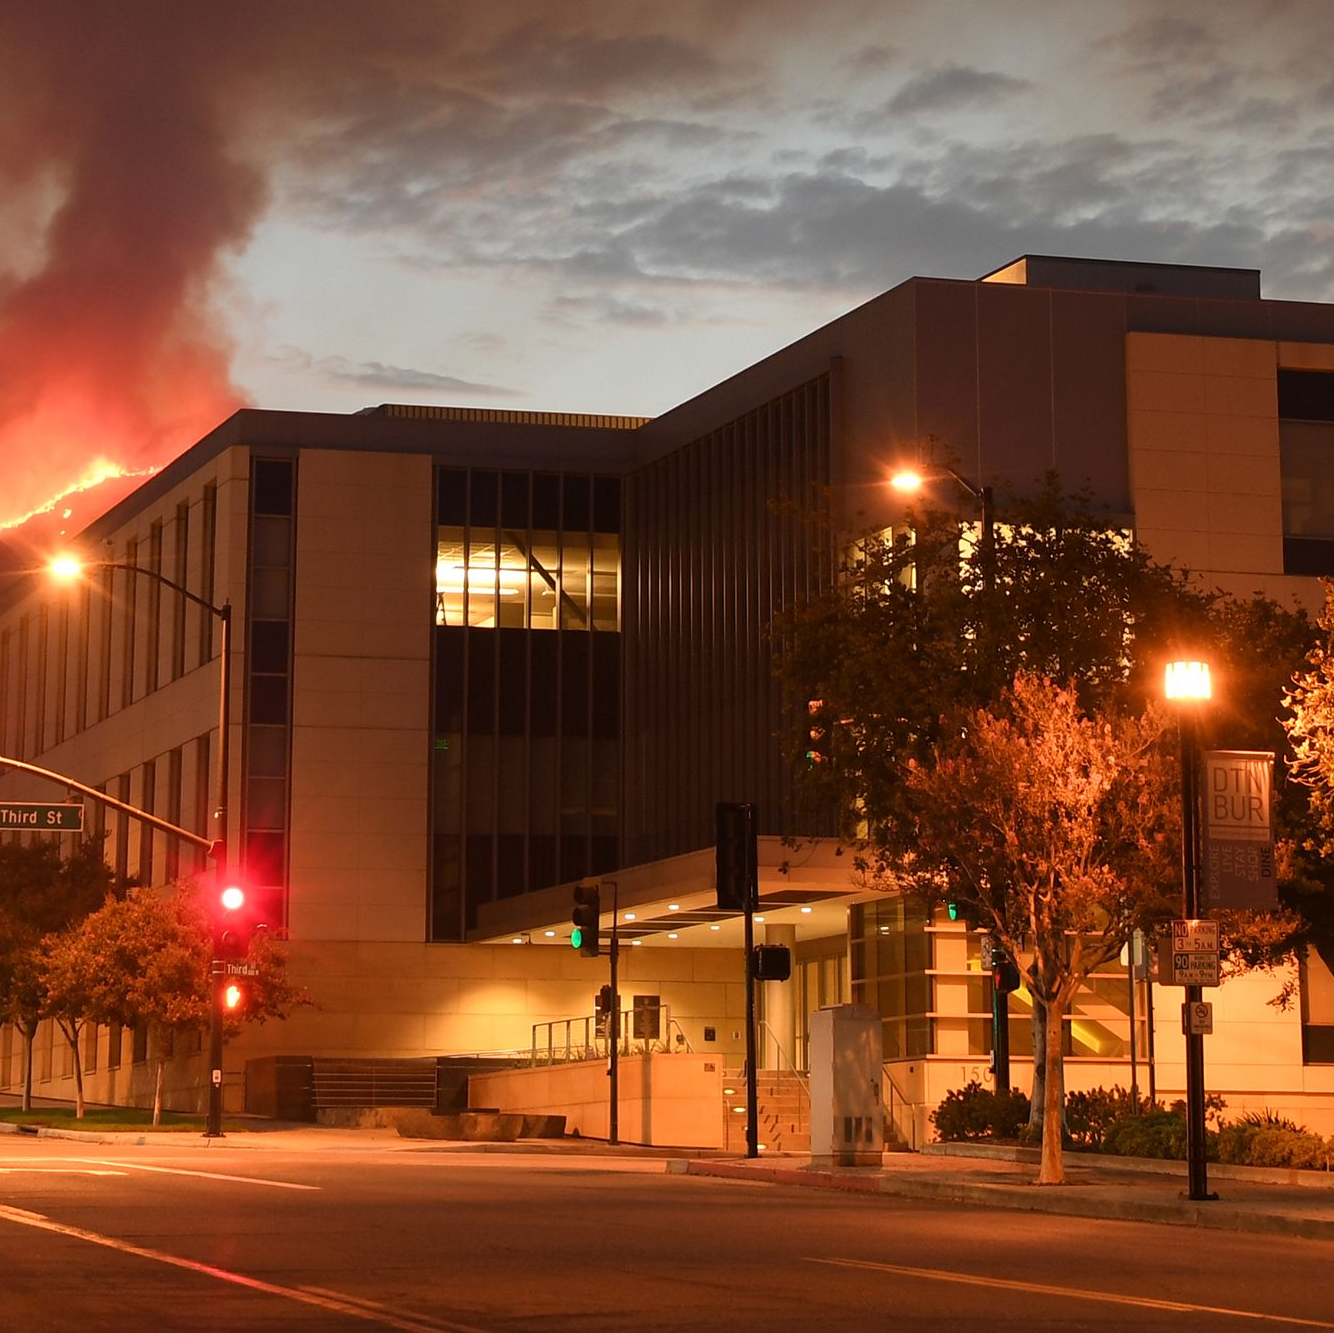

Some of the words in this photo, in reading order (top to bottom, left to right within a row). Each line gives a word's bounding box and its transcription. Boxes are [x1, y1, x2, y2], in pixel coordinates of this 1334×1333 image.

[1213, 767, 1263, 794] DTN
[0, 809, 38, 824] Third
[46, 810, 63, 825] St
[1213, 794, 1264, 822] BUR
[1209, 845, 1220, 899] EXPLORE
[1222, 845, 1233, 873] LIVE
[1234, 846, 1246, 878] STAY
[1247, 845, 1259, 882] SHOP
[1260, 847, 1272, 878] DINE
[1174, 921, 1188, 938] NO
[1178, 938, 1184, 949] 3
[227, 963, 248, 975] Third
[1175, 954, 1188, 969] 90
[960, 1065, 994, 1083] 150
